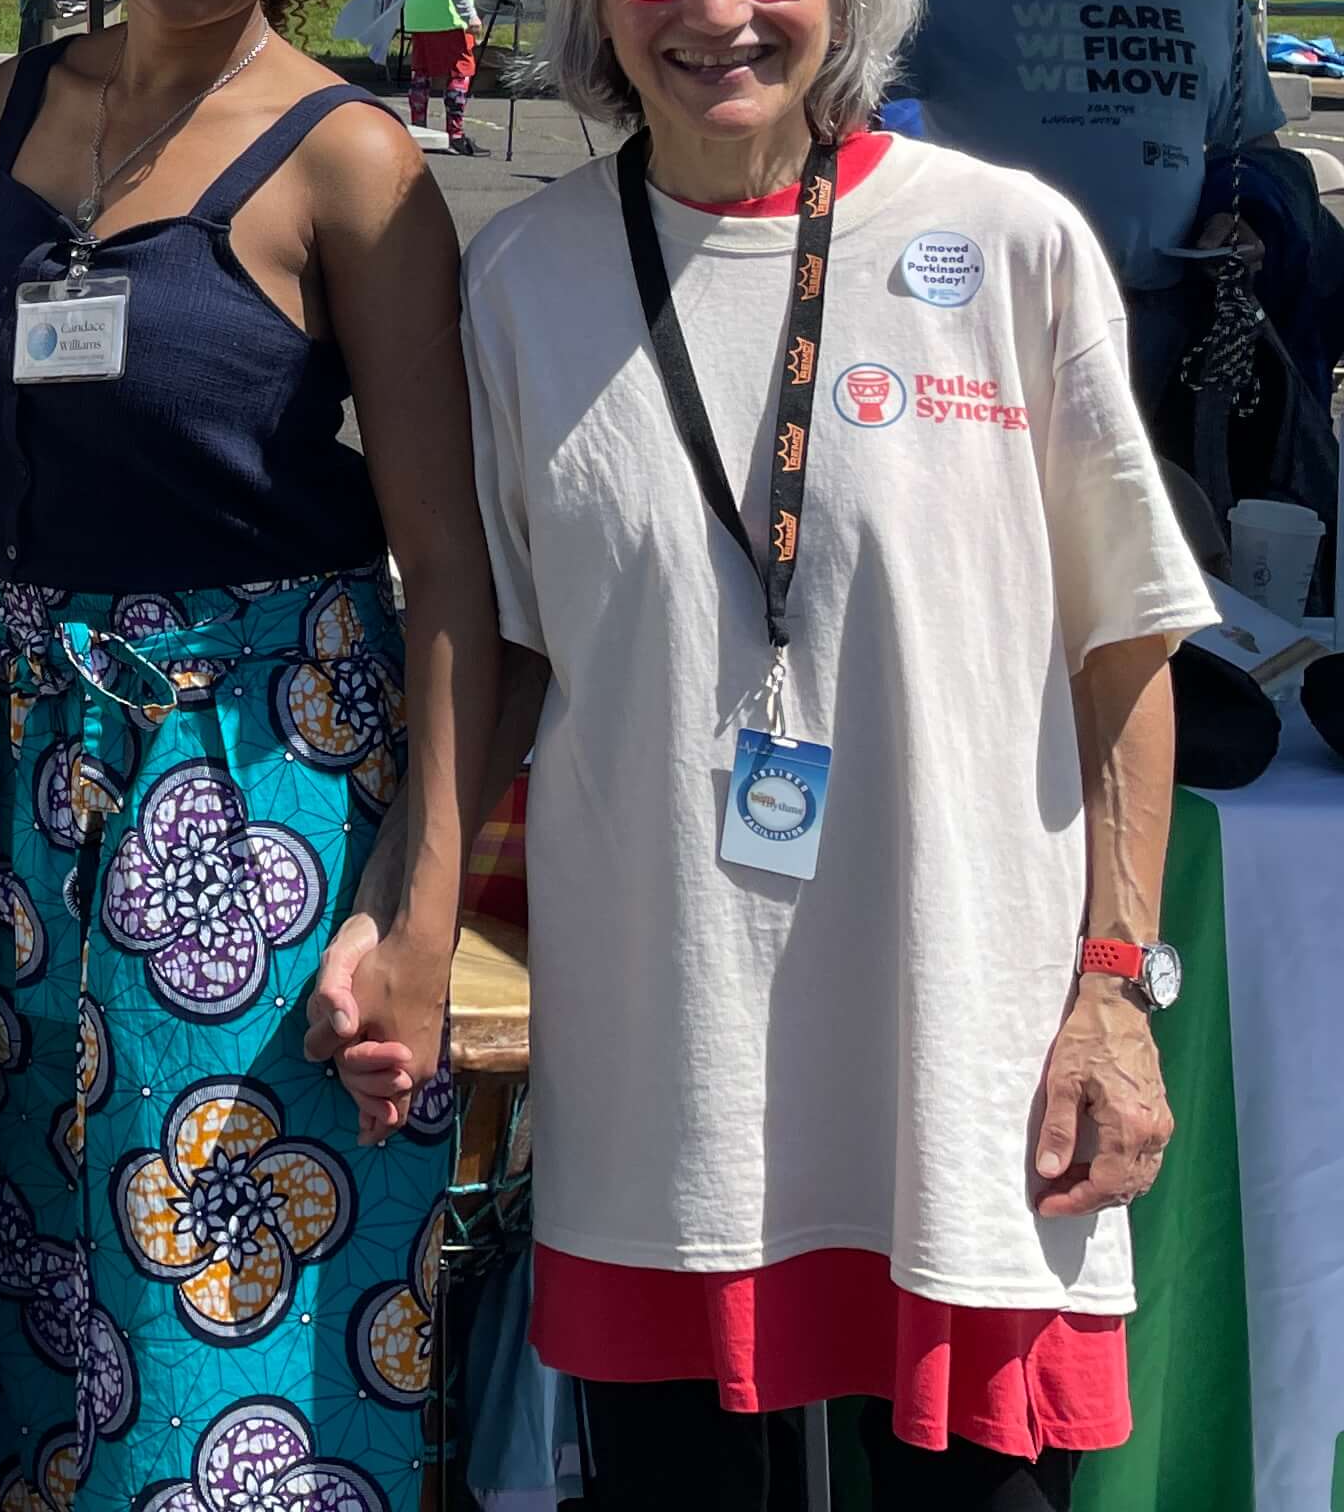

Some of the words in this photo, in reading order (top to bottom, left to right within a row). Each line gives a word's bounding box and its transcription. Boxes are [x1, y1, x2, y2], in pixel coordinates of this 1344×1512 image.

[1079, 4, 1185, 34] CARE
[1083, 35, 1197, 65] FIGHT
[1086, 68, 1199, 101] MOVE
[918, 242, 923, 252] I
[925, 242, 969, 253] moved
[924, 254, 938, 263] to
[941, 254, 965, 264] end
[907, 262, 980, 273] Parkinson's
[922, 274, 966, 287] today!
[914, 373, 999, 399] Pulse
[752, 768, 809, 793] TRAINED
[743, 815, 804, 841] FACILITATOR
